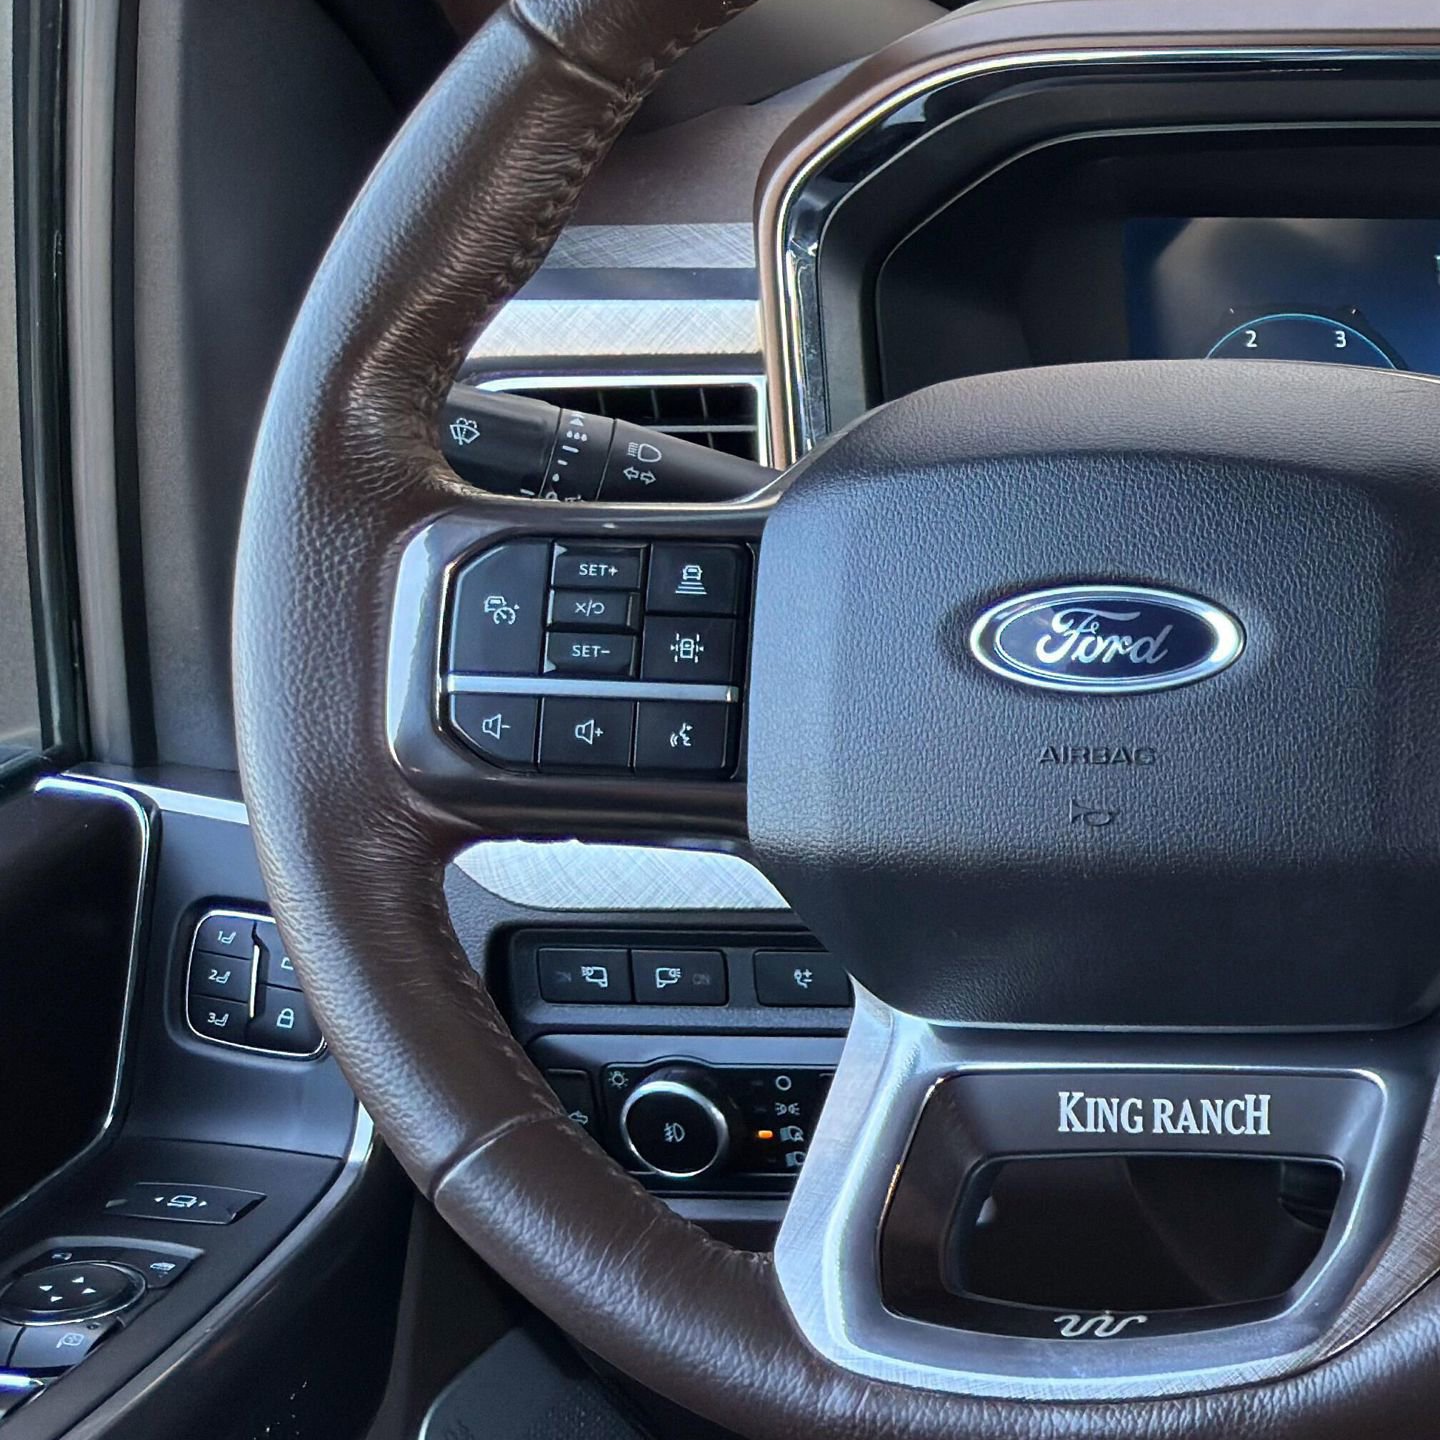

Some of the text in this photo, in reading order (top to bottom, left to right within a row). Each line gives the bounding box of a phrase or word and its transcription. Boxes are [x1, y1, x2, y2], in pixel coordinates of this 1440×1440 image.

[1246, 330, 1257, 347] 2
[1336, 331, 1346, 347] 3
[1035, 608, 1172, 665] Ford
[1039, 746, 1157, 765] AIRBAG
[1058, 1092, 1270, 1134] KING RANCH
